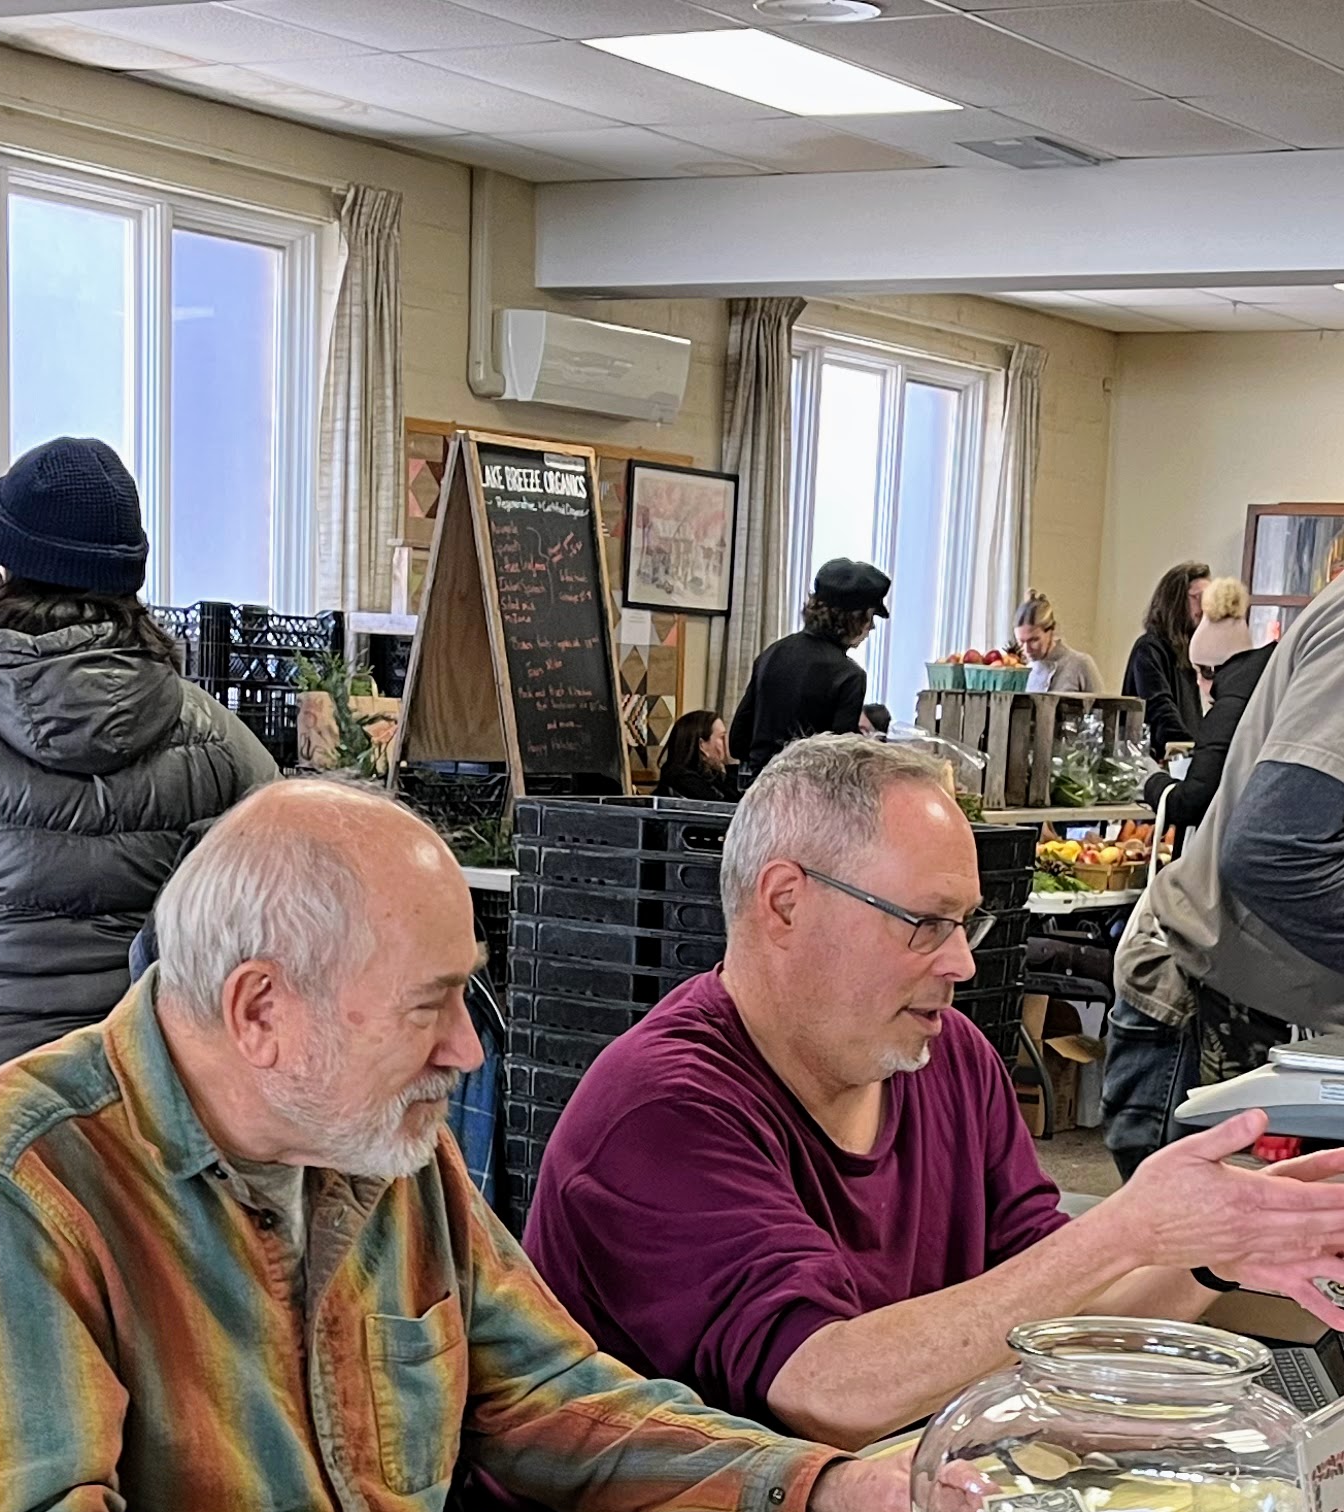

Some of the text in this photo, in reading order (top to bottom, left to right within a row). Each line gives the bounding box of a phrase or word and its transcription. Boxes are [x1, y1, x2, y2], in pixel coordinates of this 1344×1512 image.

[481, 465, 587, 499] LAKE BREEZE ORGANICS
